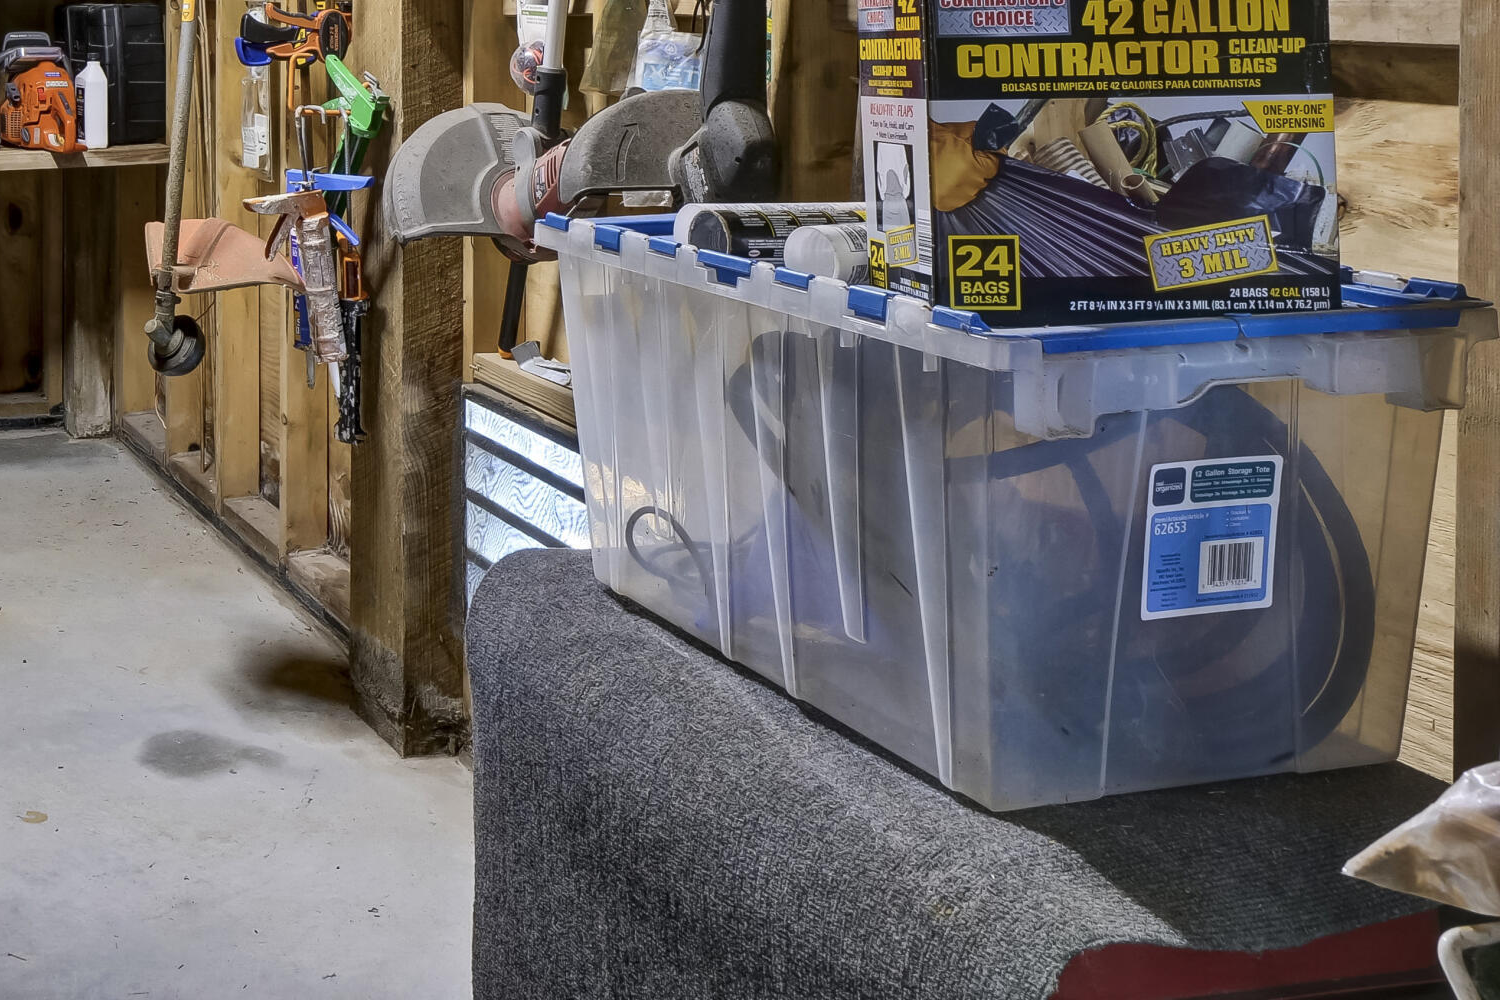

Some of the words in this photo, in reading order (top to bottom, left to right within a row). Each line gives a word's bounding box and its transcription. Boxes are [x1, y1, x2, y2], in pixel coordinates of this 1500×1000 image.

[896, 16, 920, 31] GALLON
[972, 10, 1035, 27] CHOICE
[1081, 0, 1135, 35] 42
[859, 37, 922, 61] CONTRACTOR
[1228, 36, 1306, 55] CLEAN-UP
[956, 40, 1221, 79] CONTRACTOR
[1229, 57, 1277, 75] BAGS
[1001, 81, 1038, 93] BOLSAS
[1039, 81, 1052, 92] DE
[1053, 80, 1095, 92] LIMPIEZA
[1096, 80, 1108, 91] DE
[1110, 80, 1120, 91] 42
[1121, 79, 1164, 91] GALONES
[1165, 79, 1189, 89] PARA
[1192, 78, 1261, 89] CONTRATISTAS
[1265, 117, 1325, 130] DISPENSING
[1161, 236, 1210, 257] HEAVY
[1216, 227, 1256, 246] DUTY
[871, 244, 885, 270] 24
[956, 245, 1014, 277] 24
[1179, 257, 1195, 278] 3
[1202, 249, 1249, 275] MIL
[960, 281, 1010, 294] BAGS
[1230, 288, 1241, 298] 24
[1242, 288, 1268, 298] BAGS
[1270, 288, 1280, 298] 42
[1282, 288, 1300, 298] GAL
[1301, 287, 1319, 298] (158
[963, 295, 1008, 304] BOLSAS
[1070, 302, 1077, 311] 2
[1077, 302, 1089, 311] FT
[1089, 302, 1095, 311] 8
[1107, 302, 1118, 311] IN
[1119, 302, 1126, 311] X
[1127, 302, 1133, 311] 3
[1135, 302, 1145, 311] FT
[1146, 302, 1152, 311] 9
[1165, 301, 1175, 311] IN
[1176, 301, 1184, 311] X
[1185, 301, 1191, 311] 3
[1192, 301, 1210, 311] MIL
[1211, 301, 1231, 311] (83.1
[1249, 301, 1256, 311] X
[1258, 301, 1274, 311] 1.14
[1285, 301, 1293, 310] X
[1295, 301, 1311, 310] 76.2
[1205, 469, 1225, 477] Gallon
[1228, 467, 1252, 476] Storage
[1154, 521, 1187, 536] 62653
